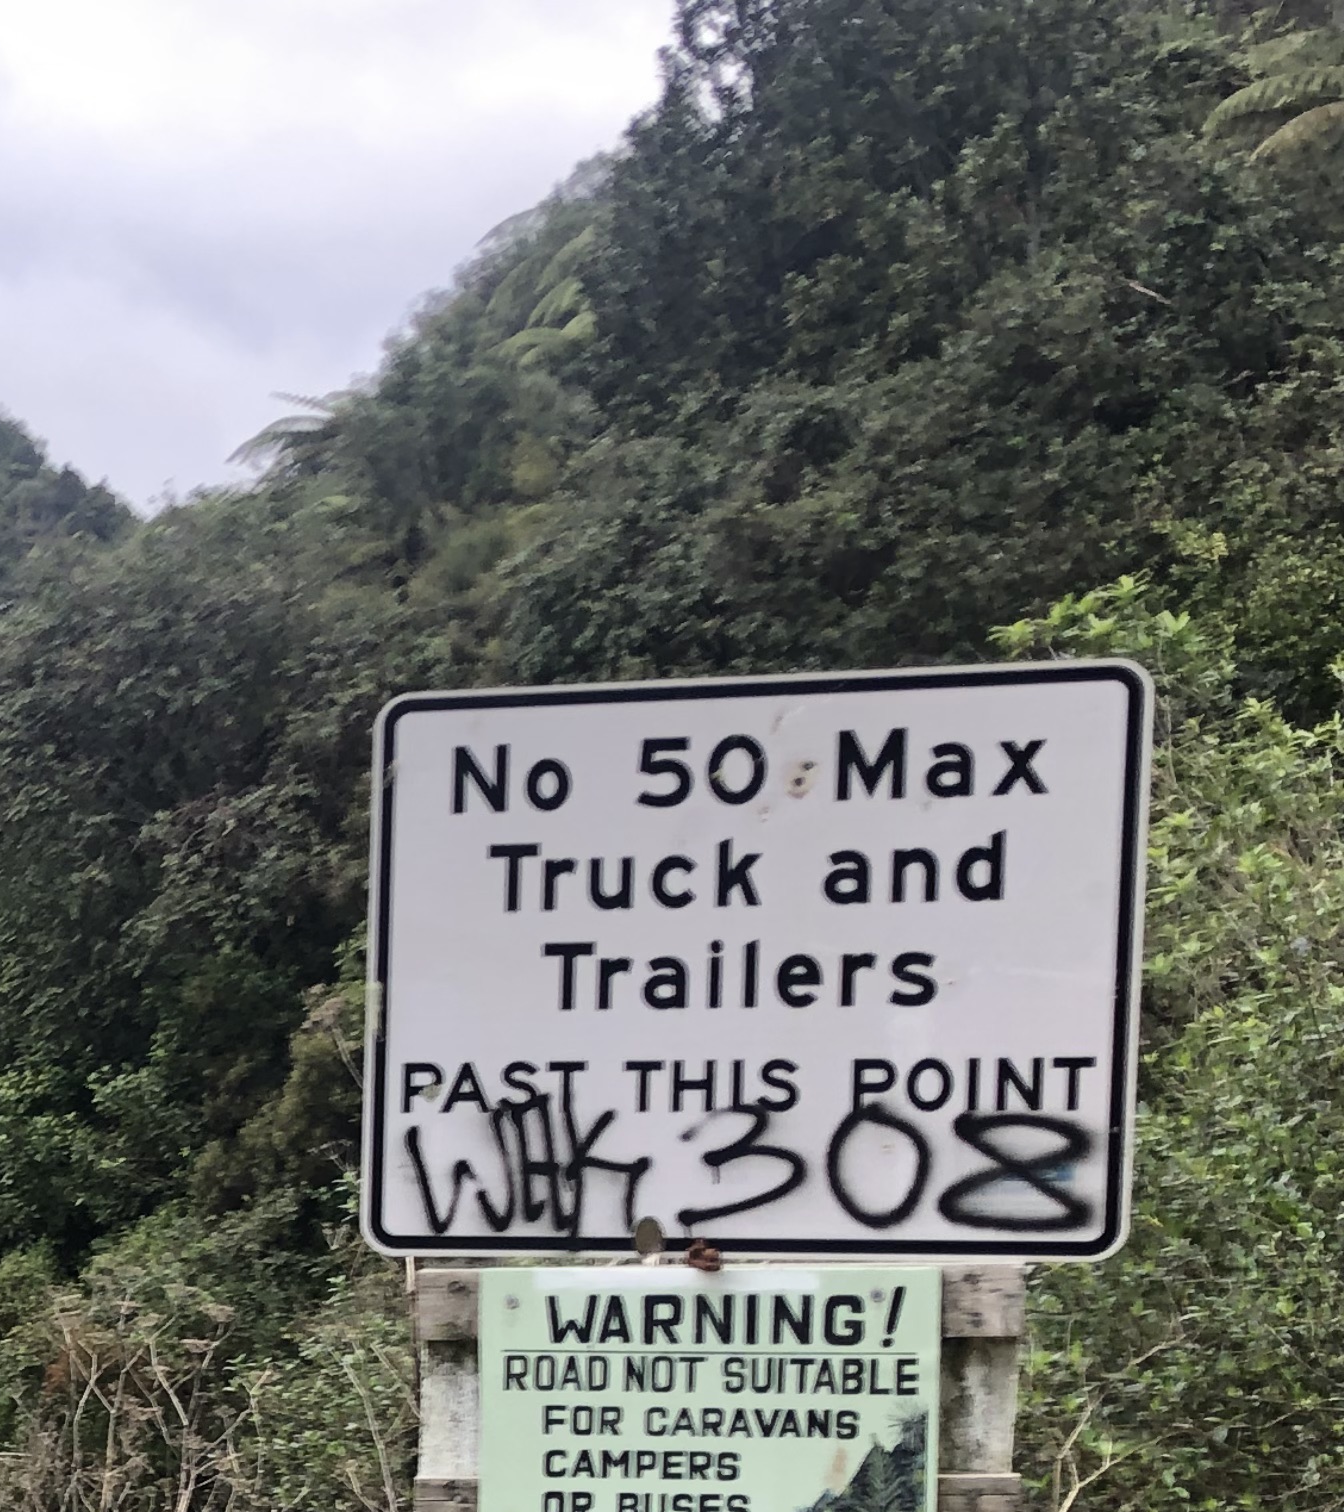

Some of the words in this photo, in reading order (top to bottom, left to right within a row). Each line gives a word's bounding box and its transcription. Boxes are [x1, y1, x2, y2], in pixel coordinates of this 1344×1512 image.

[452, 743, 571, 815] No
[636, 733, 767, 809] 50
[835, 726, 1048, 802] Max
[488, 837, 762, 913] Truck
[822, 829, 1007, 906] and
[543, 939, 938, 1012] Trailers
[401, 1061, 589, 1114] PAST
[623, 1059, 800, 1113] THIS
[851, 1056, 1097, 1112] POINT
[547, 1285, 906, 1349] WARNING!
[503, 1355, 609, 1392] ROAD
[624, 1355, 706, 1394] NOT
[723, 1356, 919, 1397] SUITABLE
[543, 1404, 623, 1437] FOR
[645, 1405, 859, 1441] CARAVANS
[544, 1448, 740, 1482] CAMPERS
